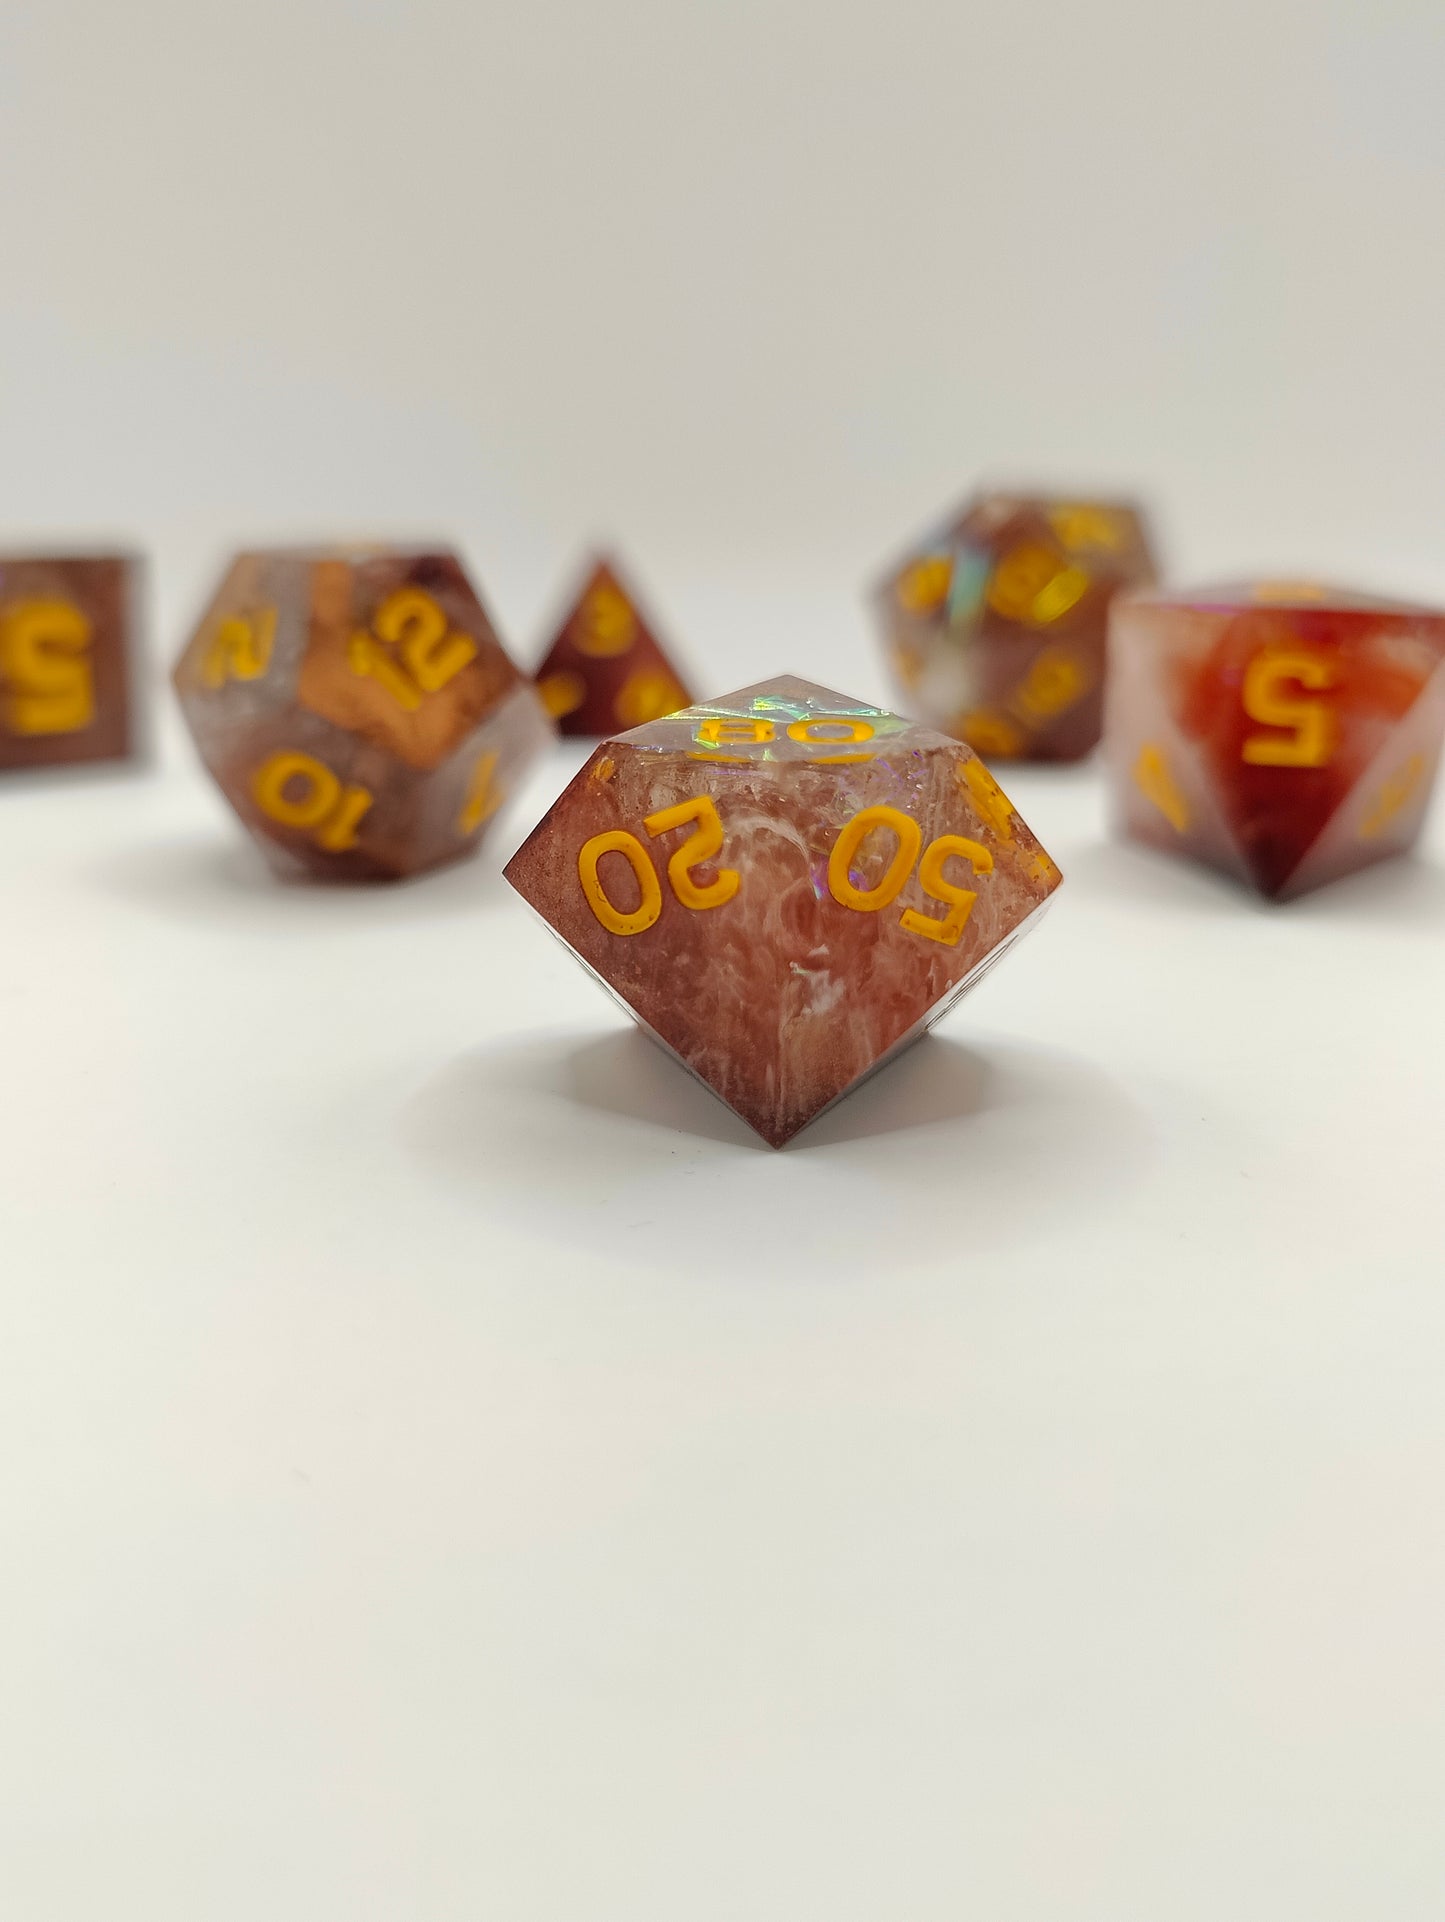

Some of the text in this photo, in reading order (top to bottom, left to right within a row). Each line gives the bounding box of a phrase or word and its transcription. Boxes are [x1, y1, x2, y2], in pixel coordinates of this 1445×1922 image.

[4, 599, 93, 734] 5
[348, 587, 478, 711] 12
[1242, 653, 1330, 768] 5
[698, 718, 875, 745] 80
[254, 752, 373, 850] 10
[577, 795, 740, 936] 20
[827, 806, 992, 946] 50
